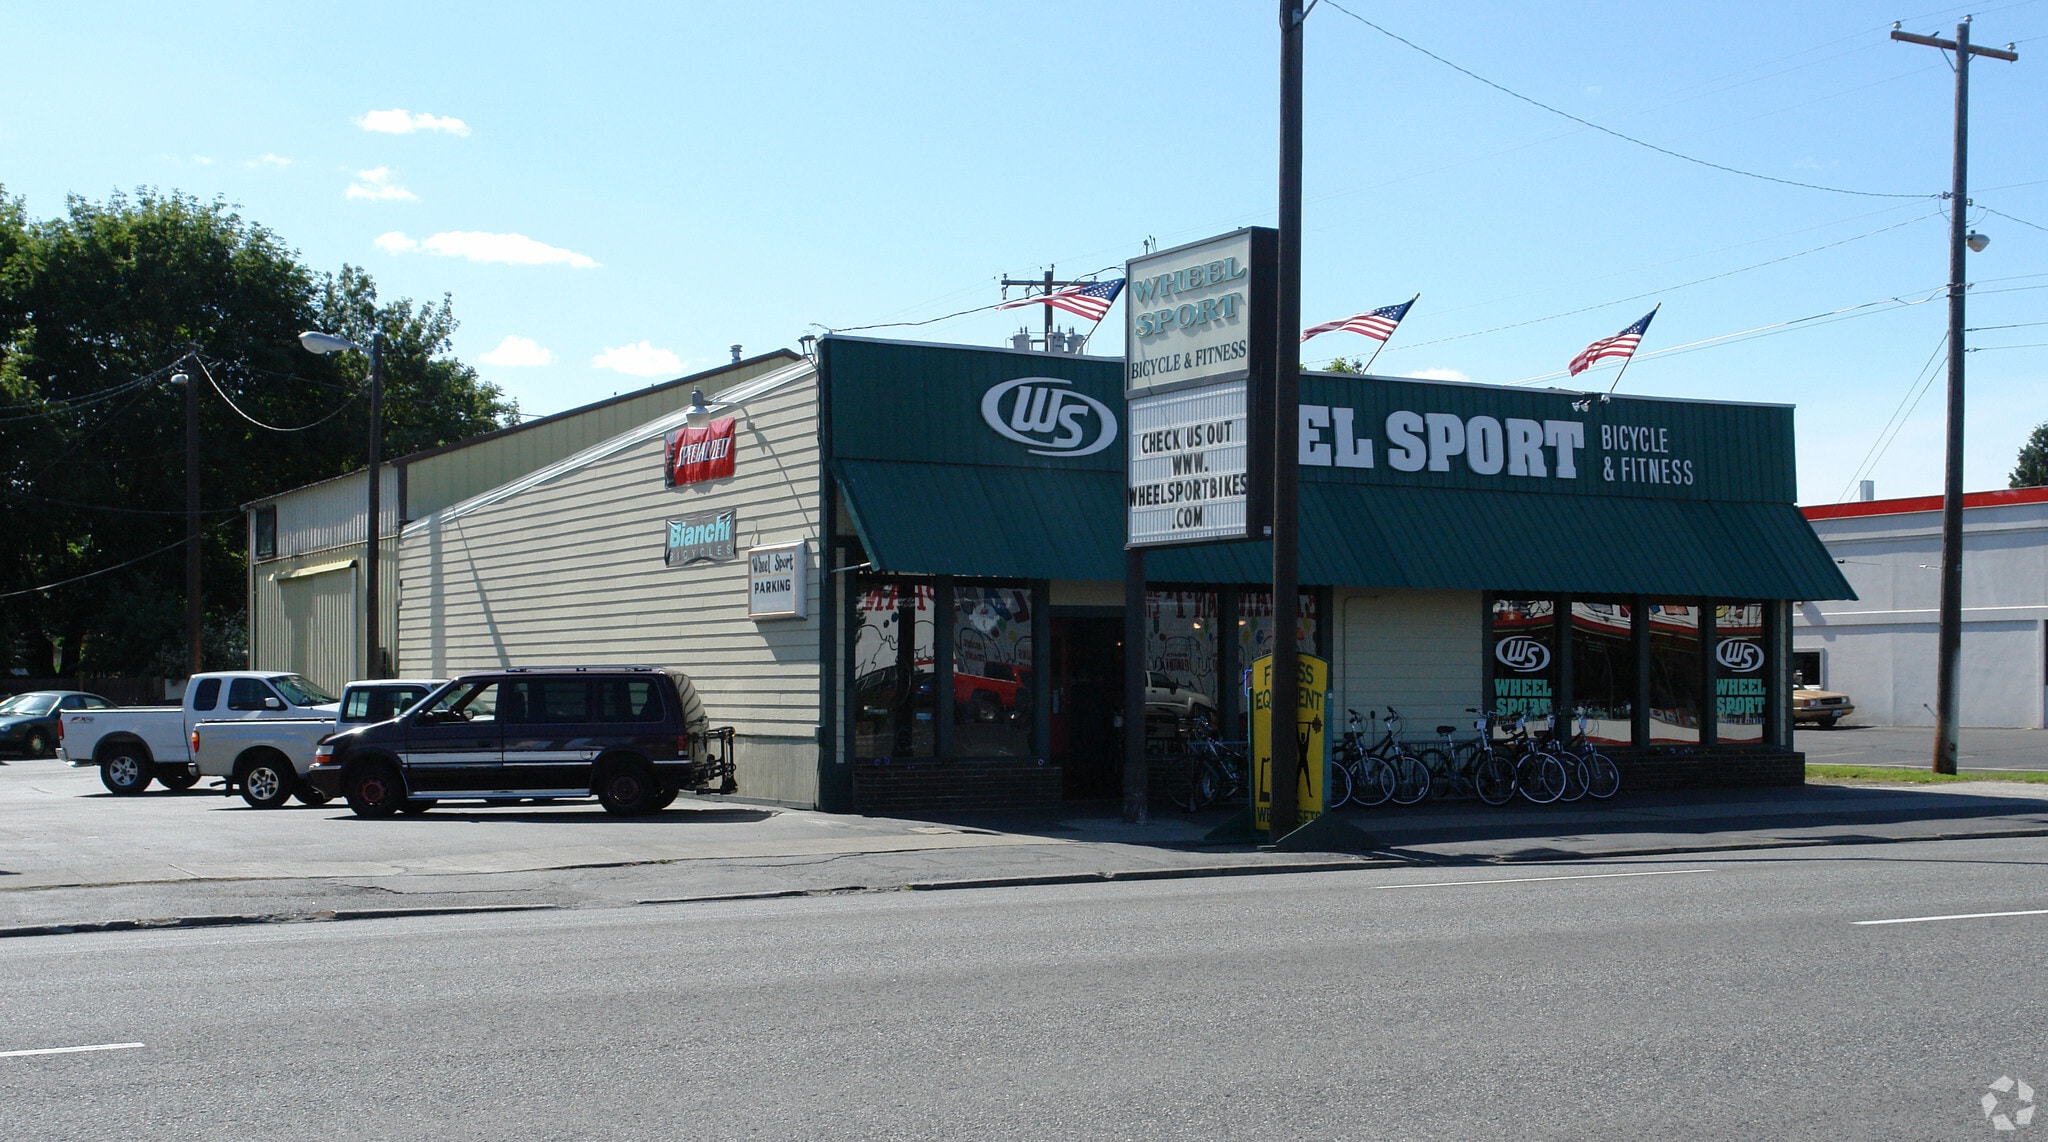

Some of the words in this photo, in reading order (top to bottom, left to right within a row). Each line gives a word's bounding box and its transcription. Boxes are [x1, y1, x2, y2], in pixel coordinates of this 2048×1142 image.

[1132, 256, 1247, 303] WHEEL
[1135, 292, 1242, 338] SPORT
[1131, 353, 1181, 379] BICYCLE
[1183, 352, 1192, 369] &
[1195, 339, 1247, 367] FITNESS
[1005, 383, 1095, 451] WS
[1141, 428, 1181, 454] CHECK
[1186, 425, 1203, 448] US
[1207, 421, 1232, 445] OUT
[1385, 409, 1585, 479] SPORT
[1601, 424, 1669, 454] BICYCLE
[1172, 452, 1209, 476] WWW.
[1603, 457, 1615, 482] &
[1621, 457, 1694, 486] FITNESS
[1129, 472, 1247, 507] WHEELSPORTBIKES
[669, 513, 732, 549] Bianchi
[1172, 507, 1203, 530] .COM
[669, 544, 731, 562] BICYCLES
[752, 554, 771, 575] Wheel
[774, 553, 794, 573] Sport
[754, 578, 791, 595] PARKING
[1504, 638, 1543, 669] WS
[1722, 639, 1756, 670] WS
[1494, 678, 1552, 697] WHEEL
[1716, 678, 1766, 696] WHEEL
[1495, 697, 1552, 718] SPORT
[1716, 697, 1765, 714] SPORT
